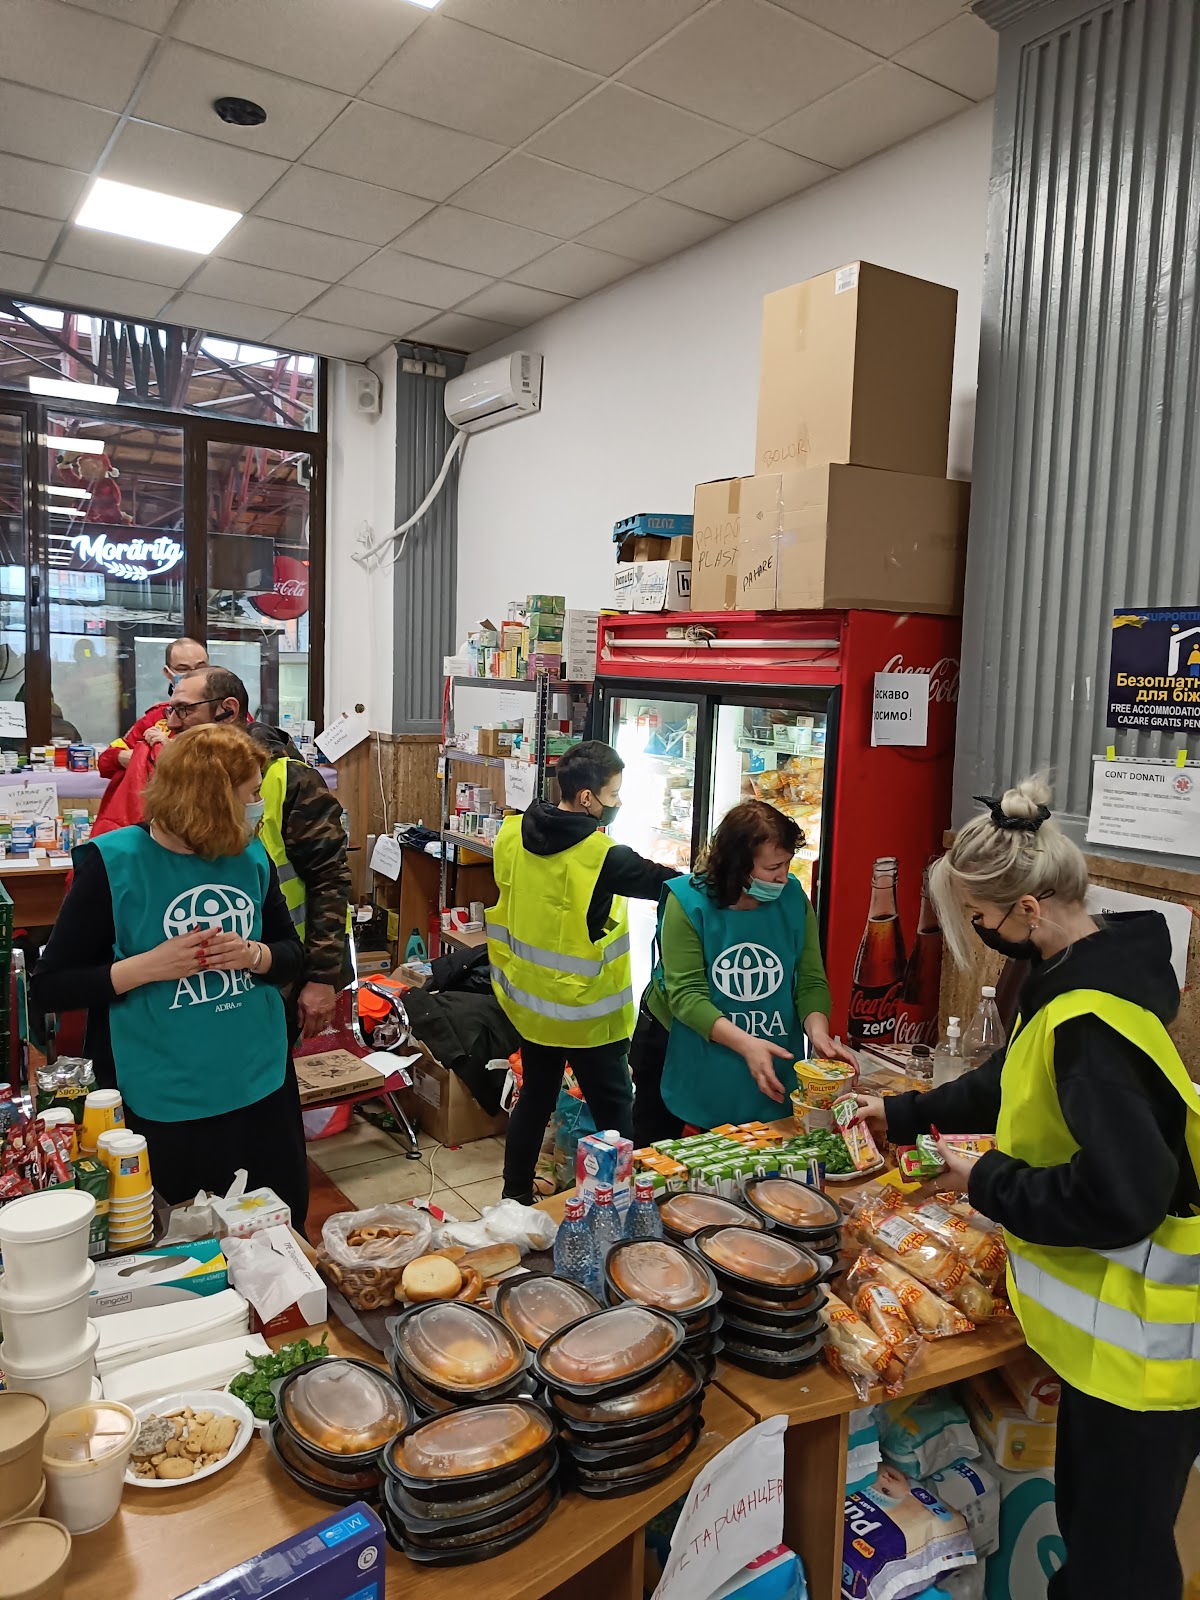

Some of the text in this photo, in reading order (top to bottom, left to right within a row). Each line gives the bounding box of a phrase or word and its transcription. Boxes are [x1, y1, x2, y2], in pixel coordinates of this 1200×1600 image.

[742, 555, 774, 592] PAHARE
[874, 687, 910, 700] аскаво
[1136, 689, 1168, 703] для
[1110, 703, 1132, 714] FREE
[1117, 715, 1149, 726] CAZARE
[1150, 717, 1182, 727] GRATIS
[1104, 770, 1166, 784] CONT DONATII
[729, 1010, 788, 1037] DRA
[862, 1017, 896, 1036] zero
[59, 1087, 89, 1097] JACOBS
[100, 1294, 129, 1307] bingold
[686, 1483, 711, 1521] ЛЯ
[347, 1517, 362, 1529] M
[854, 1540, 875, 1557] NEW
